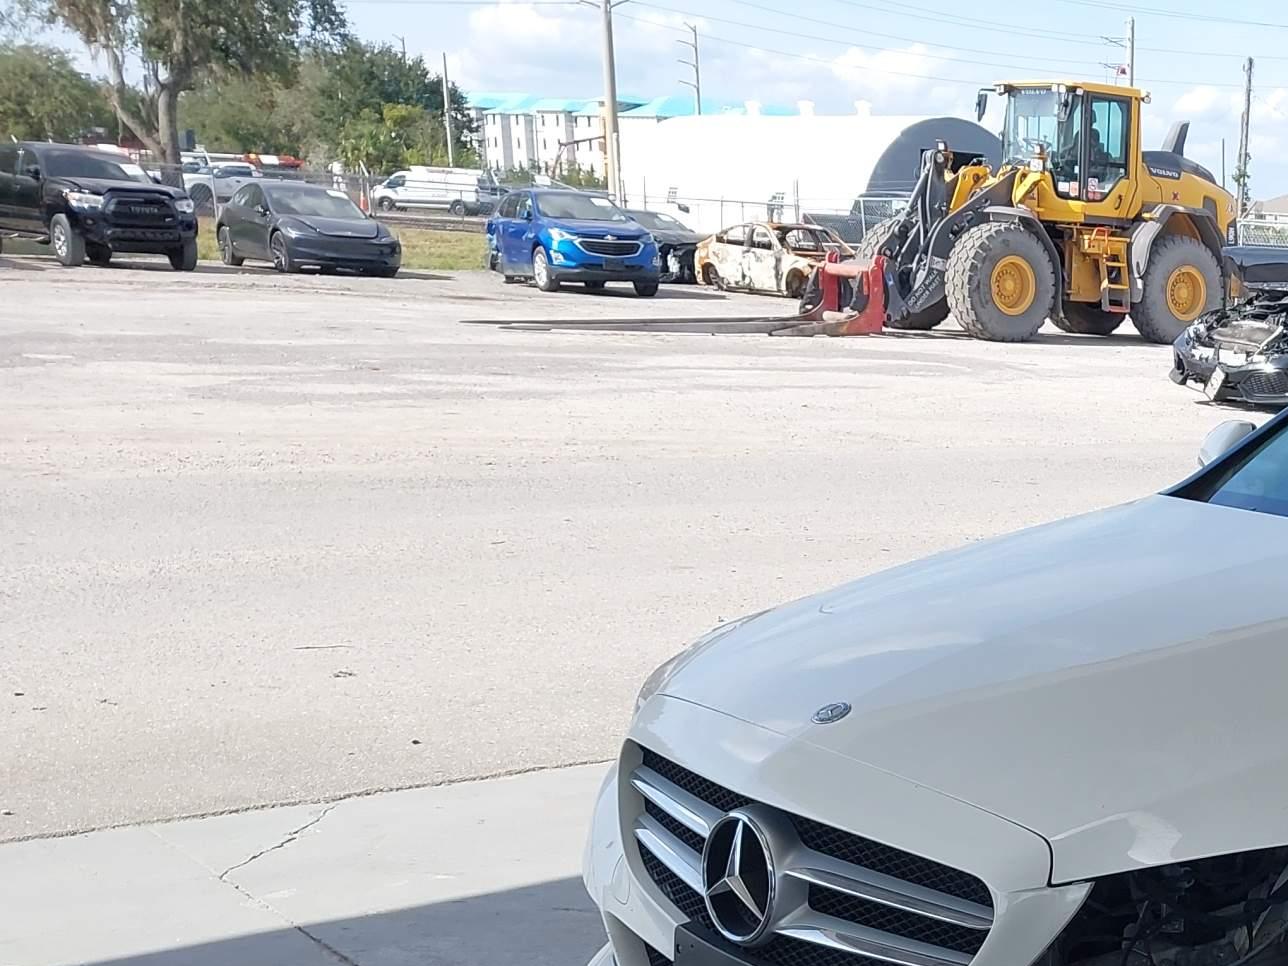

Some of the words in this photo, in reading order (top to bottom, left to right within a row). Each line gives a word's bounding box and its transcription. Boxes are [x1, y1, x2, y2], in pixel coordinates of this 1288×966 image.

[1150, 167, 1179, 178] VOLVO
[131, 206, 158, 214] TOYOTA
[907, 296, 917, 306] DO
[915, 284, 926, 298] NOT
[924, 270, 938, 285] WALK
